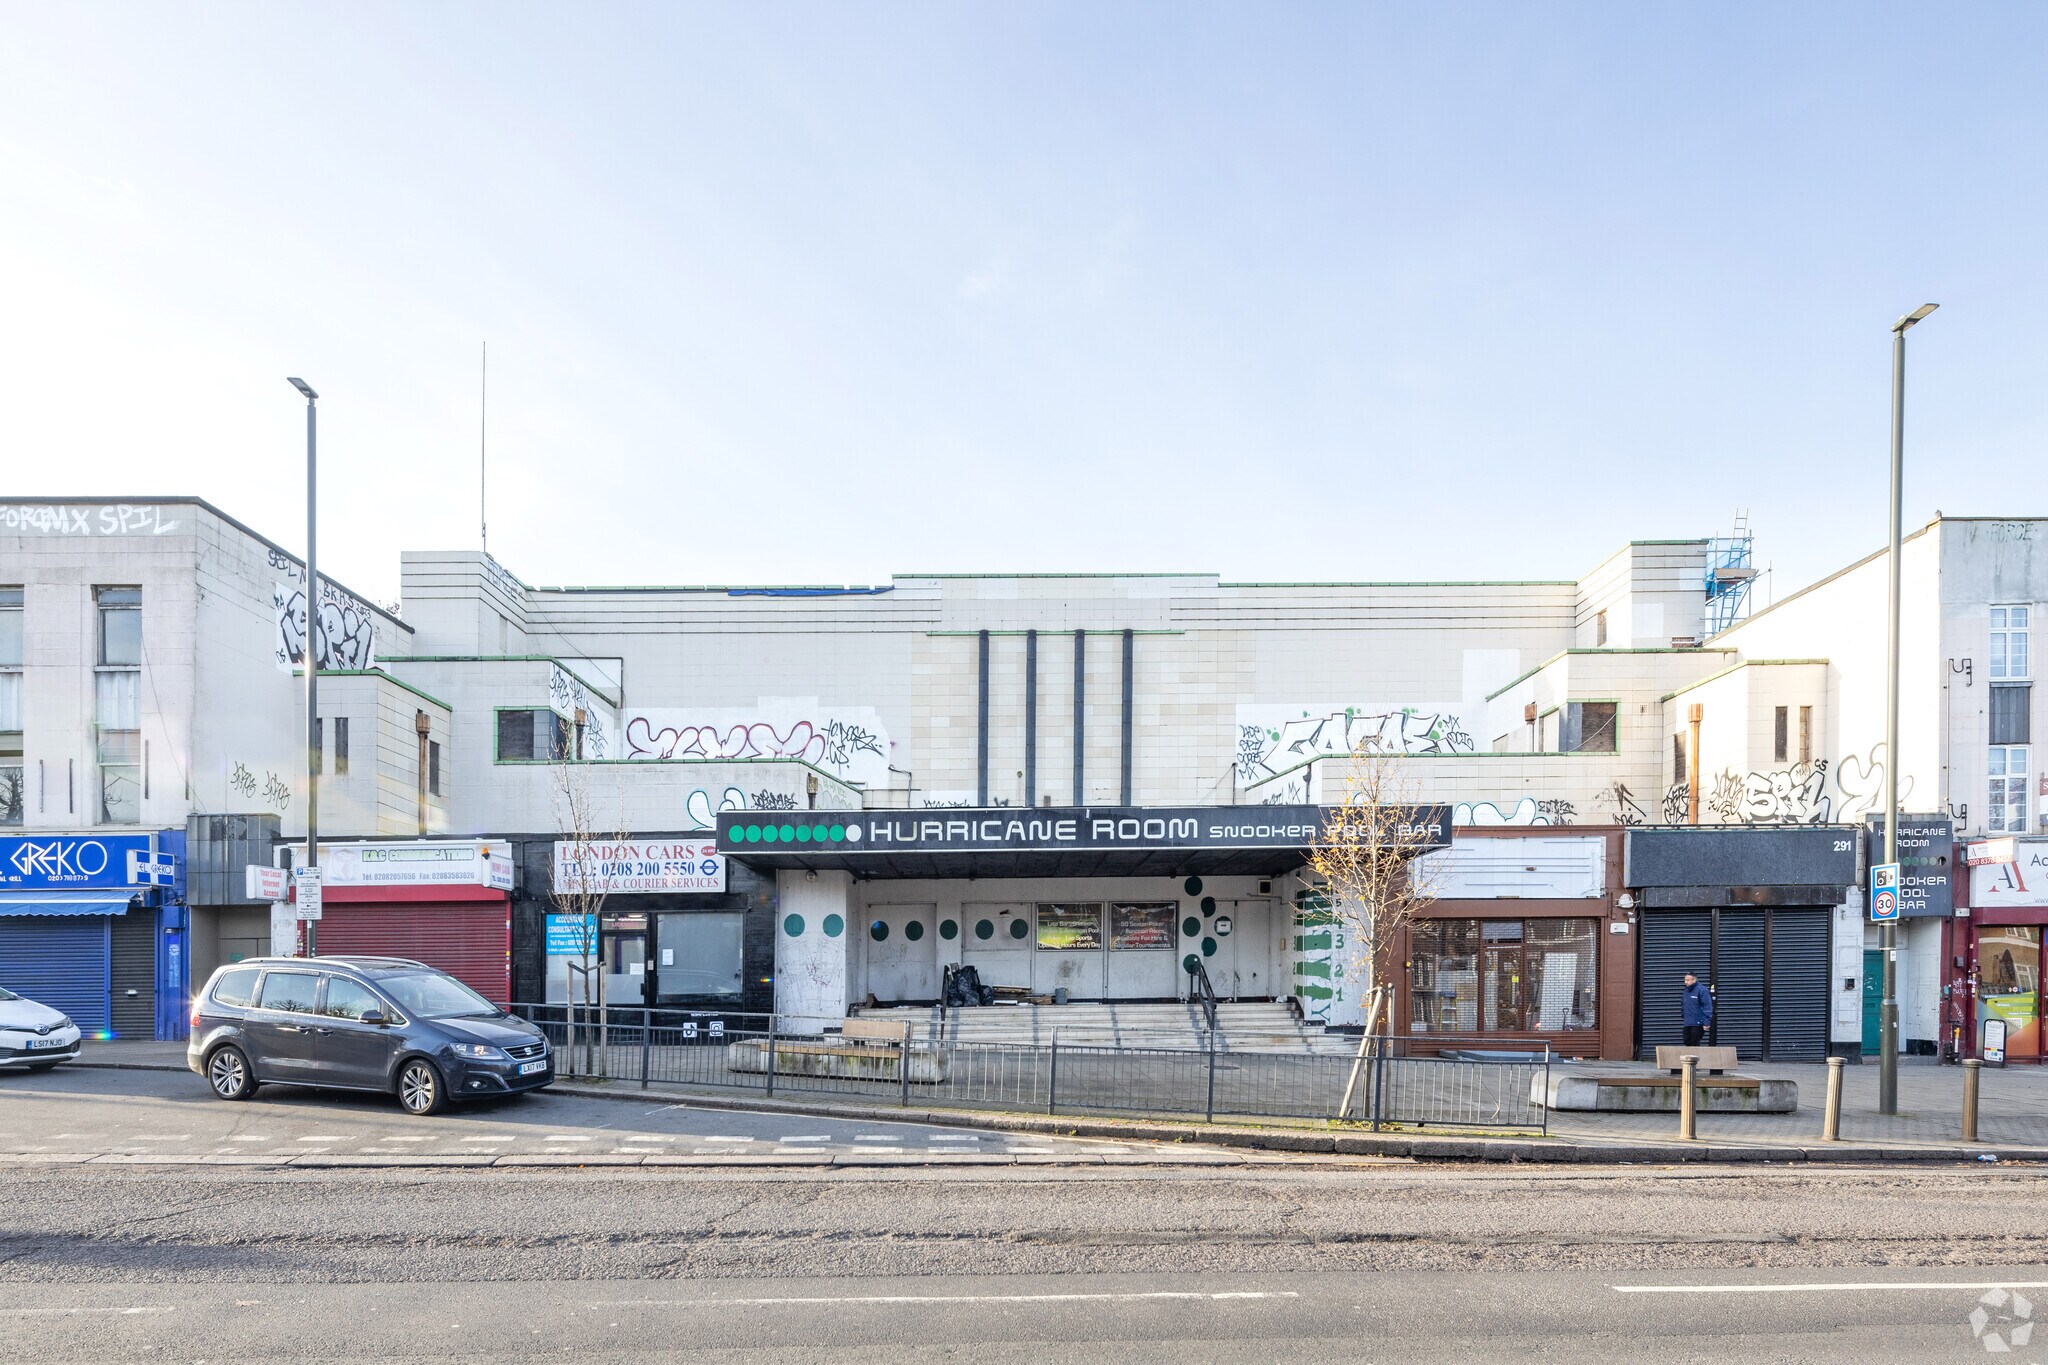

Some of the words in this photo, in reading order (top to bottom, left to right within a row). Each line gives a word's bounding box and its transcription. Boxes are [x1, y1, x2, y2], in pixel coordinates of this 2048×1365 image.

[100, 504, 181, 535] SPIL
[871, 819, 1076, 842] HURRICANE
[1092, 818, 1198, 840] ROOM
[1209, 824, 1316, 838] SNOOKER
[1398, 824, 1442, 836] BAR
[1878, 828, 1946, 836] HRRICANE
[1833, 840, 1852, 851] 291
[562, 845, 640, 860] LONDON
[645, 844, 695, 860] CARS
[139, 863, 147, 872] EL
[151, 864, 172, 875] GREKO
[561, 863, 597, 877] TEL:
[602, 862, 633, 876] 0208
[636, 862, 660, 876] 200
[664, 861, 695, 876] 5550
[612, 879, 620, 889] &
[623, 878, 668, 889] COURIER
[671, 877, 719, 889] SERVICES
[263, 889, 279, 897] Access
[1899, 888, 1931, 897] OOL
[1877, 899, 1892, 909] 30
[1335, 934, 1345, 949] 3
[1334, 964, 1344, 978] 2
[1336, 986, 1344, 1002] 1
[34, 1040, 48, 1048] LS17
